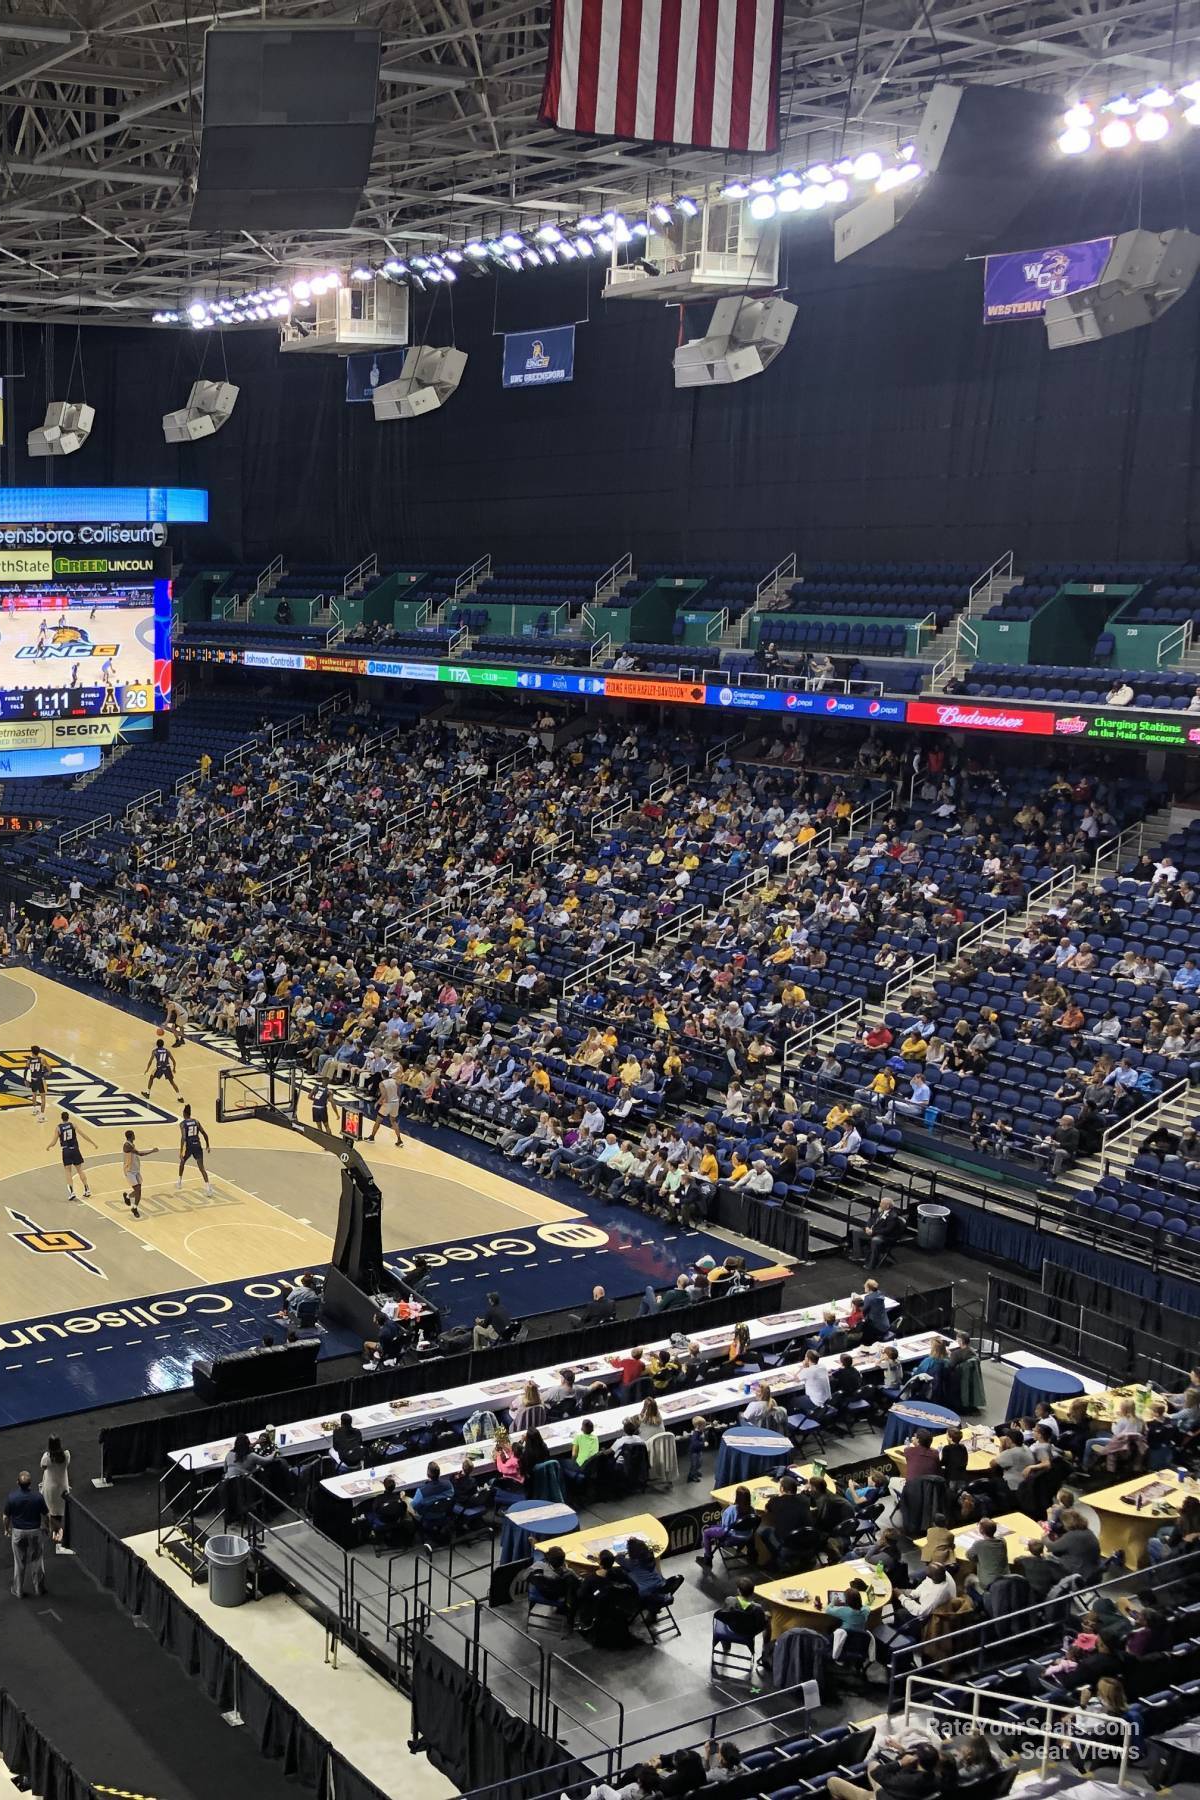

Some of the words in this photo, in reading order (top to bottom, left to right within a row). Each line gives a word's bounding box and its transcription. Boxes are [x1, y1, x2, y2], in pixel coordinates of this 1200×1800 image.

[987, 300, 1041, 316] WESTERN
[525, 357, 550, 369] UNCG
[523, 369, 565, 383] GREENSBORO
[80, 525, 156, 543] Coliseum
[53, 557, 108, 573] GREEN
[108, 559, 153, 572] LINCOLN
[14, 644, 120, 660] UNCG
[245, 652, 269, 664] Johnson
[270, 654, 295, 668] Controls
[375, 663, 403, 675] BRADY
[448, 668, 471, 683] TFA
[481, 672, 498, 681] CLUB
[606, 681, 623, 692] RIDING
[624, 683, 636, 694] HIGH
[34, 692, 69, 710] 1:11
[126, 690, 147, 709] 26
[733, 691, 766, 701] Greensboro
[733, 698, 759, 707] Coliseum
[797, 700, 813, 708] pepsi
[837, 702, 855, 711] pepsi
[880, 706, 898, 715] pepsi
[936, 705, 1024, 729] Budweiser
[55, 723, 111, 736] SEGRA
[1094, 717, 1138, 732] Charging
[1139, 721, 1182, 733] Stations
[11, 737, 38, 745] TICKETS
[1100, 729, 1114, 738] the
[1115, 731, 1137, 740] Main
[1139, 732, 1187, 744] Concourse
[260, 1019, 286, 1041] 27
[159, 1053, 167, 1062] 11
[314, 1090, 324, 1100] 2
[62, 1129, 73, 1141] 13
[187, 1125, 198, 1137] 21
